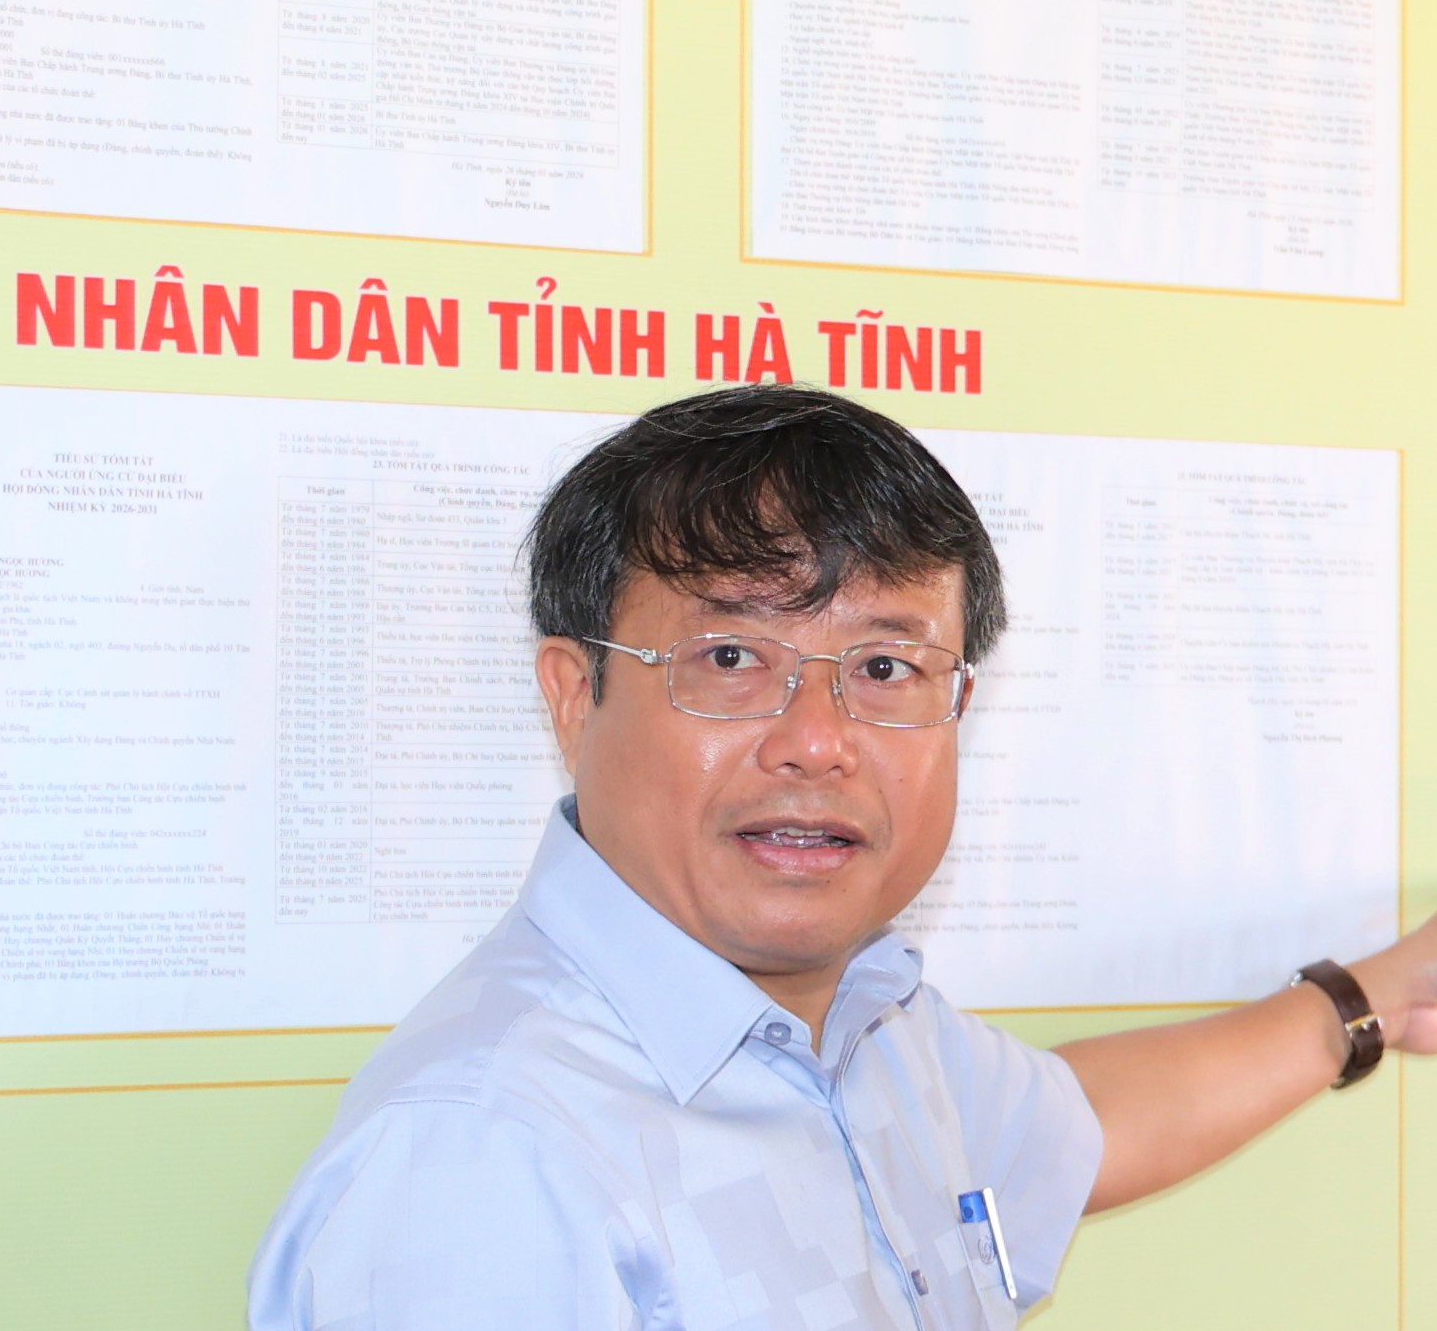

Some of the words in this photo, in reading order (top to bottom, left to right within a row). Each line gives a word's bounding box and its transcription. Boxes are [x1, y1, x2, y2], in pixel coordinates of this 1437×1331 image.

[18, 266, 258, 356] NHÂN
[293, 279, 458, 366] DÂN
[489, 277, 664, 377] TỈNH
[696, 303, 793, 386] HÀ
[819, 310, 980, 393] TĨNH
